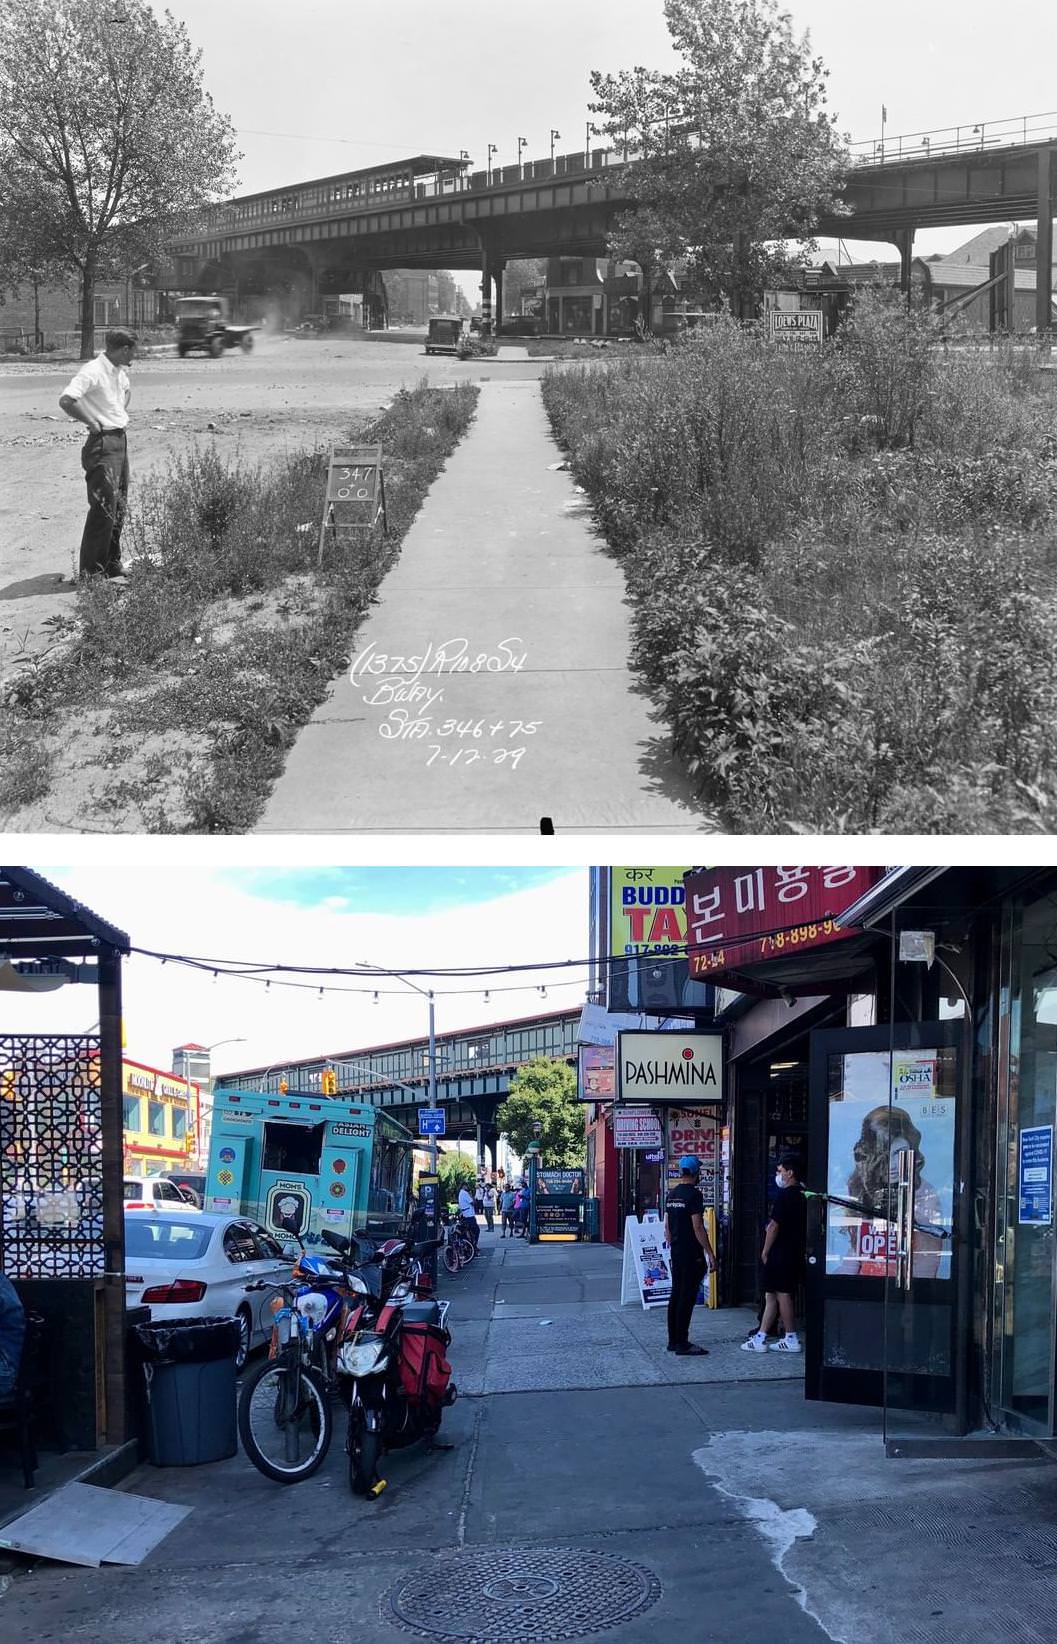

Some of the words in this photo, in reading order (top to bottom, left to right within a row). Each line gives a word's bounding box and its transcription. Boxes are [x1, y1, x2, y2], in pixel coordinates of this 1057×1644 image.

[339, 467, 372, 481] 347
[622, 907, 689, 942] TA
[625, 1061, 717, 1085] PASHMINA
[900, 1073, 931, 1082] OSHA
[332, 1127, 371, 1137] DELIGHT
[861, 1235, 903, 1254] OPE
